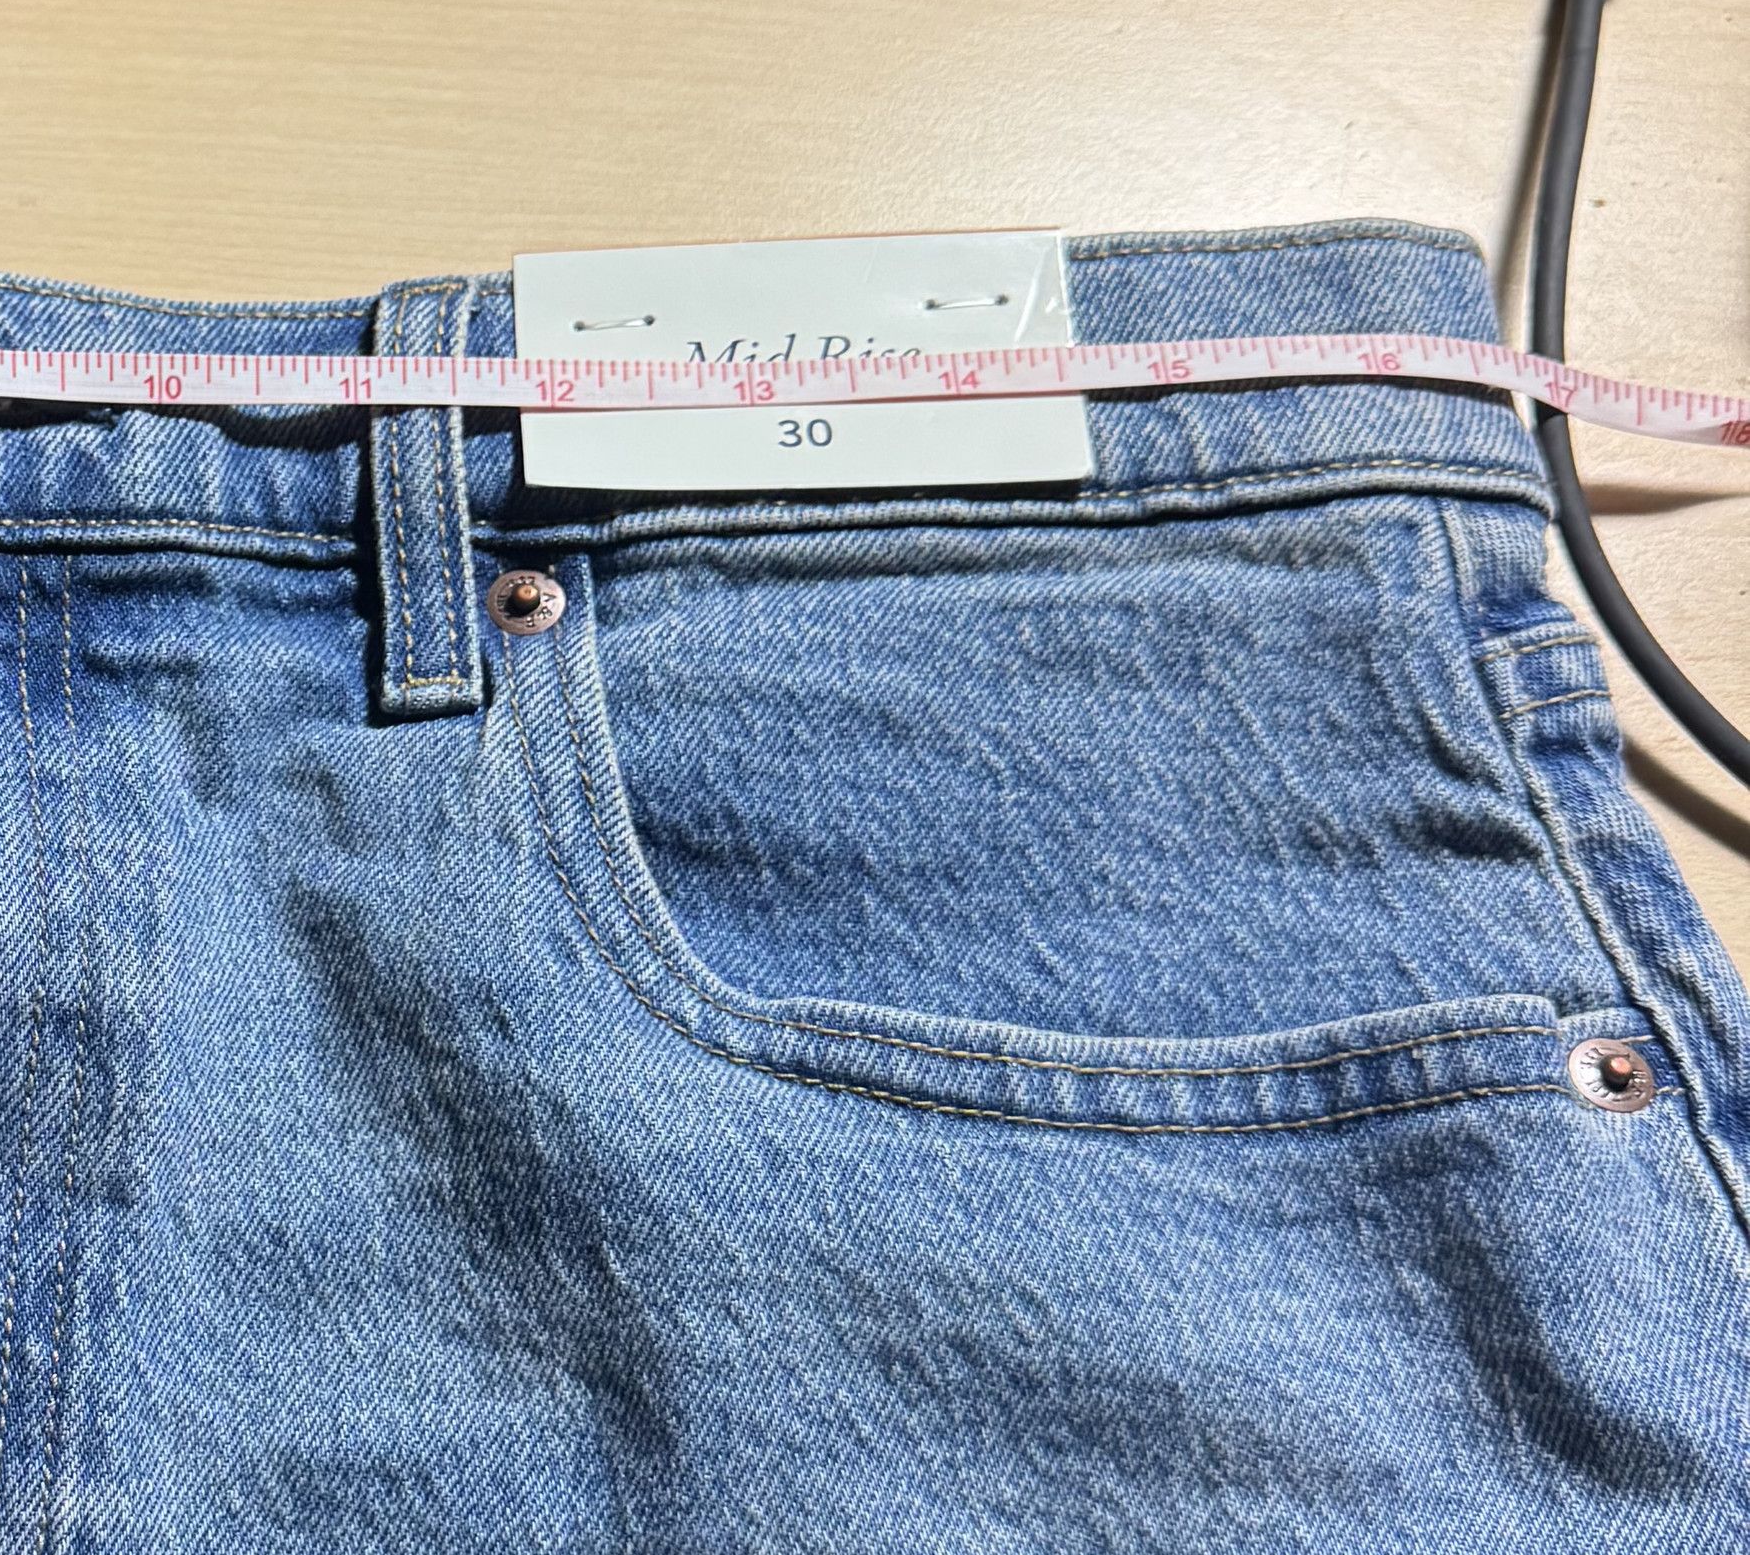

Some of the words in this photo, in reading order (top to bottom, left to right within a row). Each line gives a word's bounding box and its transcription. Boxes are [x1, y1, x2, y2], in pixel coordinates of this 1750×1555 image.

[143, 375, 182, 400] 10
[339, 377, 372, 400] 11
[535, 380, 576, 402] 12
[733, 380, 776, 402] 13
[937, 369, 981, 390] 14
[1147, 359, 1193, 381] 15
[1357, 352, 1401, 372] 16
[1544, 380, 1578, 409] 17
[777, 417, 834, 448] 30
